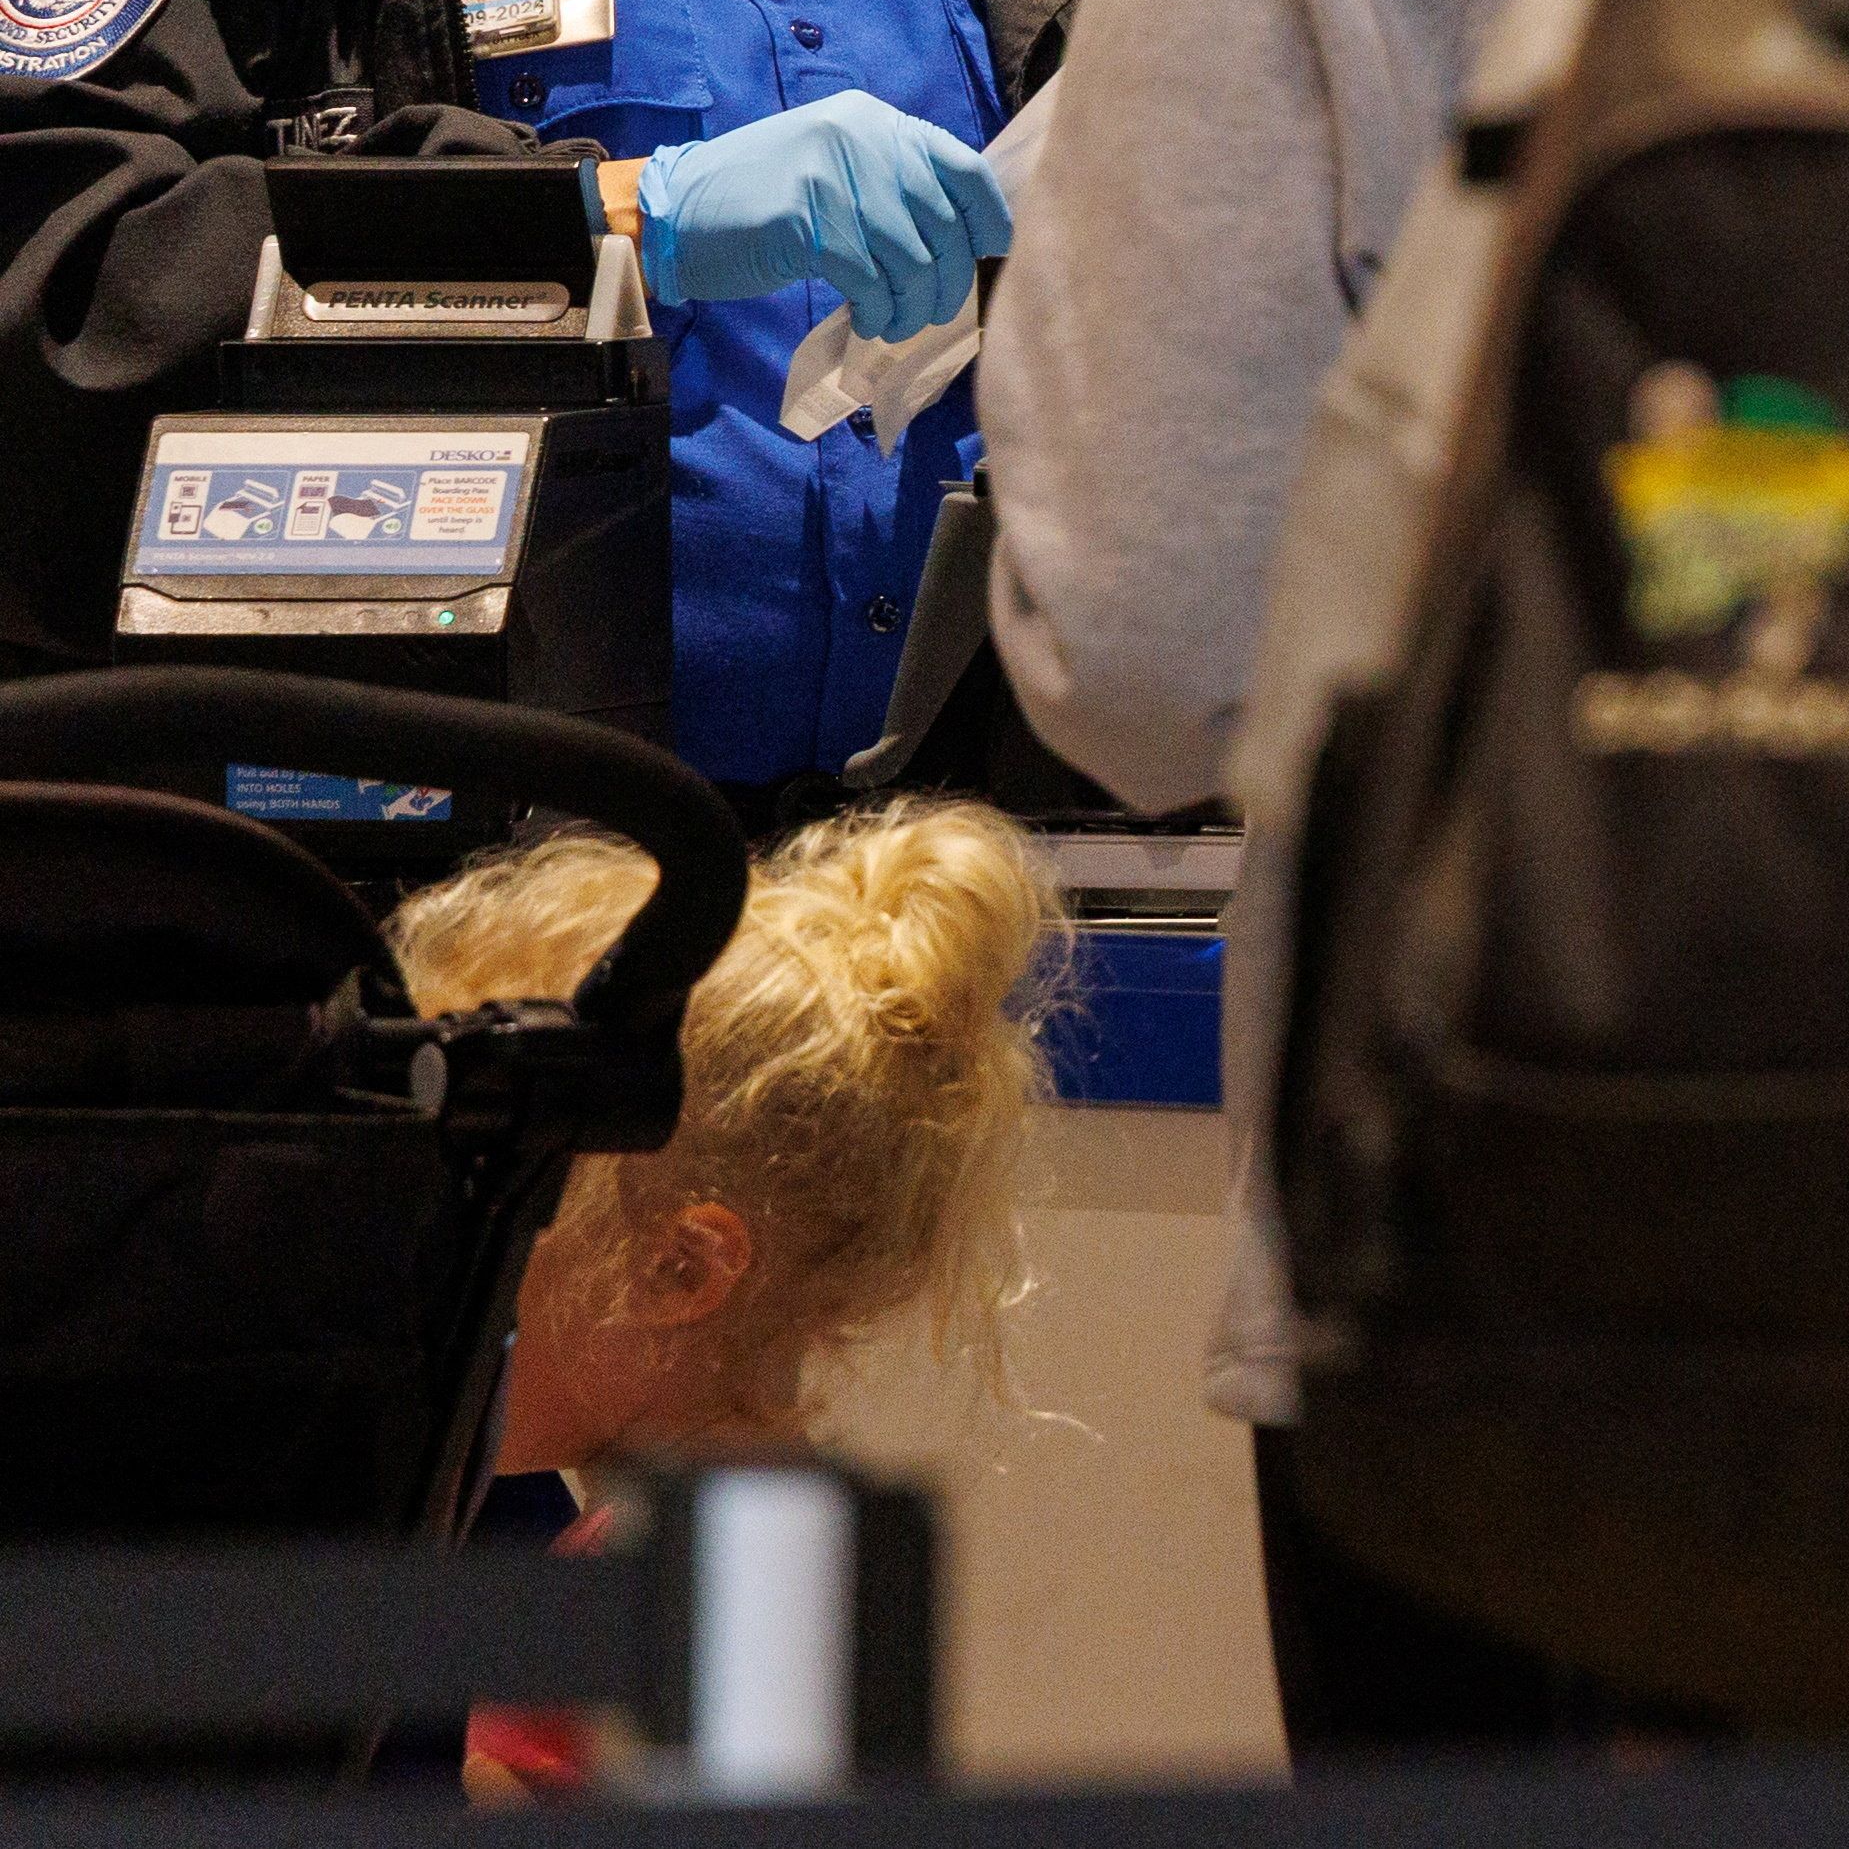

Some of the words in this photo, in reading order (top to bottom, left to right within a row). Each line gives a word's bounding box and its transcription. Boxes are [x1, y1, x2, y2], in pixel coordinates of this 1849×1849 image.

[328, 290, 415, 309] PENTA
[429, 450, 495, 461] DESKO
[174, 475, 208, 483] MOBILE
[302, 475, 331, 483] PAPER
[428, 477, 453, 485] Place
[454, 477, 498, 485] BARCODE
[432, 487, 471, 496] Boarding
[431, 496, 454, 504] FACE
[456, 496, 488, 504] DOWN
[419, 506, 444, 514] OVER
[447, 506, 464, 514] THE
[465, 506, 496, 514] GLASS
[450, 517, 474, 525] beep
[236, 783, 263, 793] INTO
[265, 783, 302, 793] HOLES
[235, 800, 267, 812] using
[269, 799, 299, 809] BOTH
[301, 799, 341, 809] HANDS
